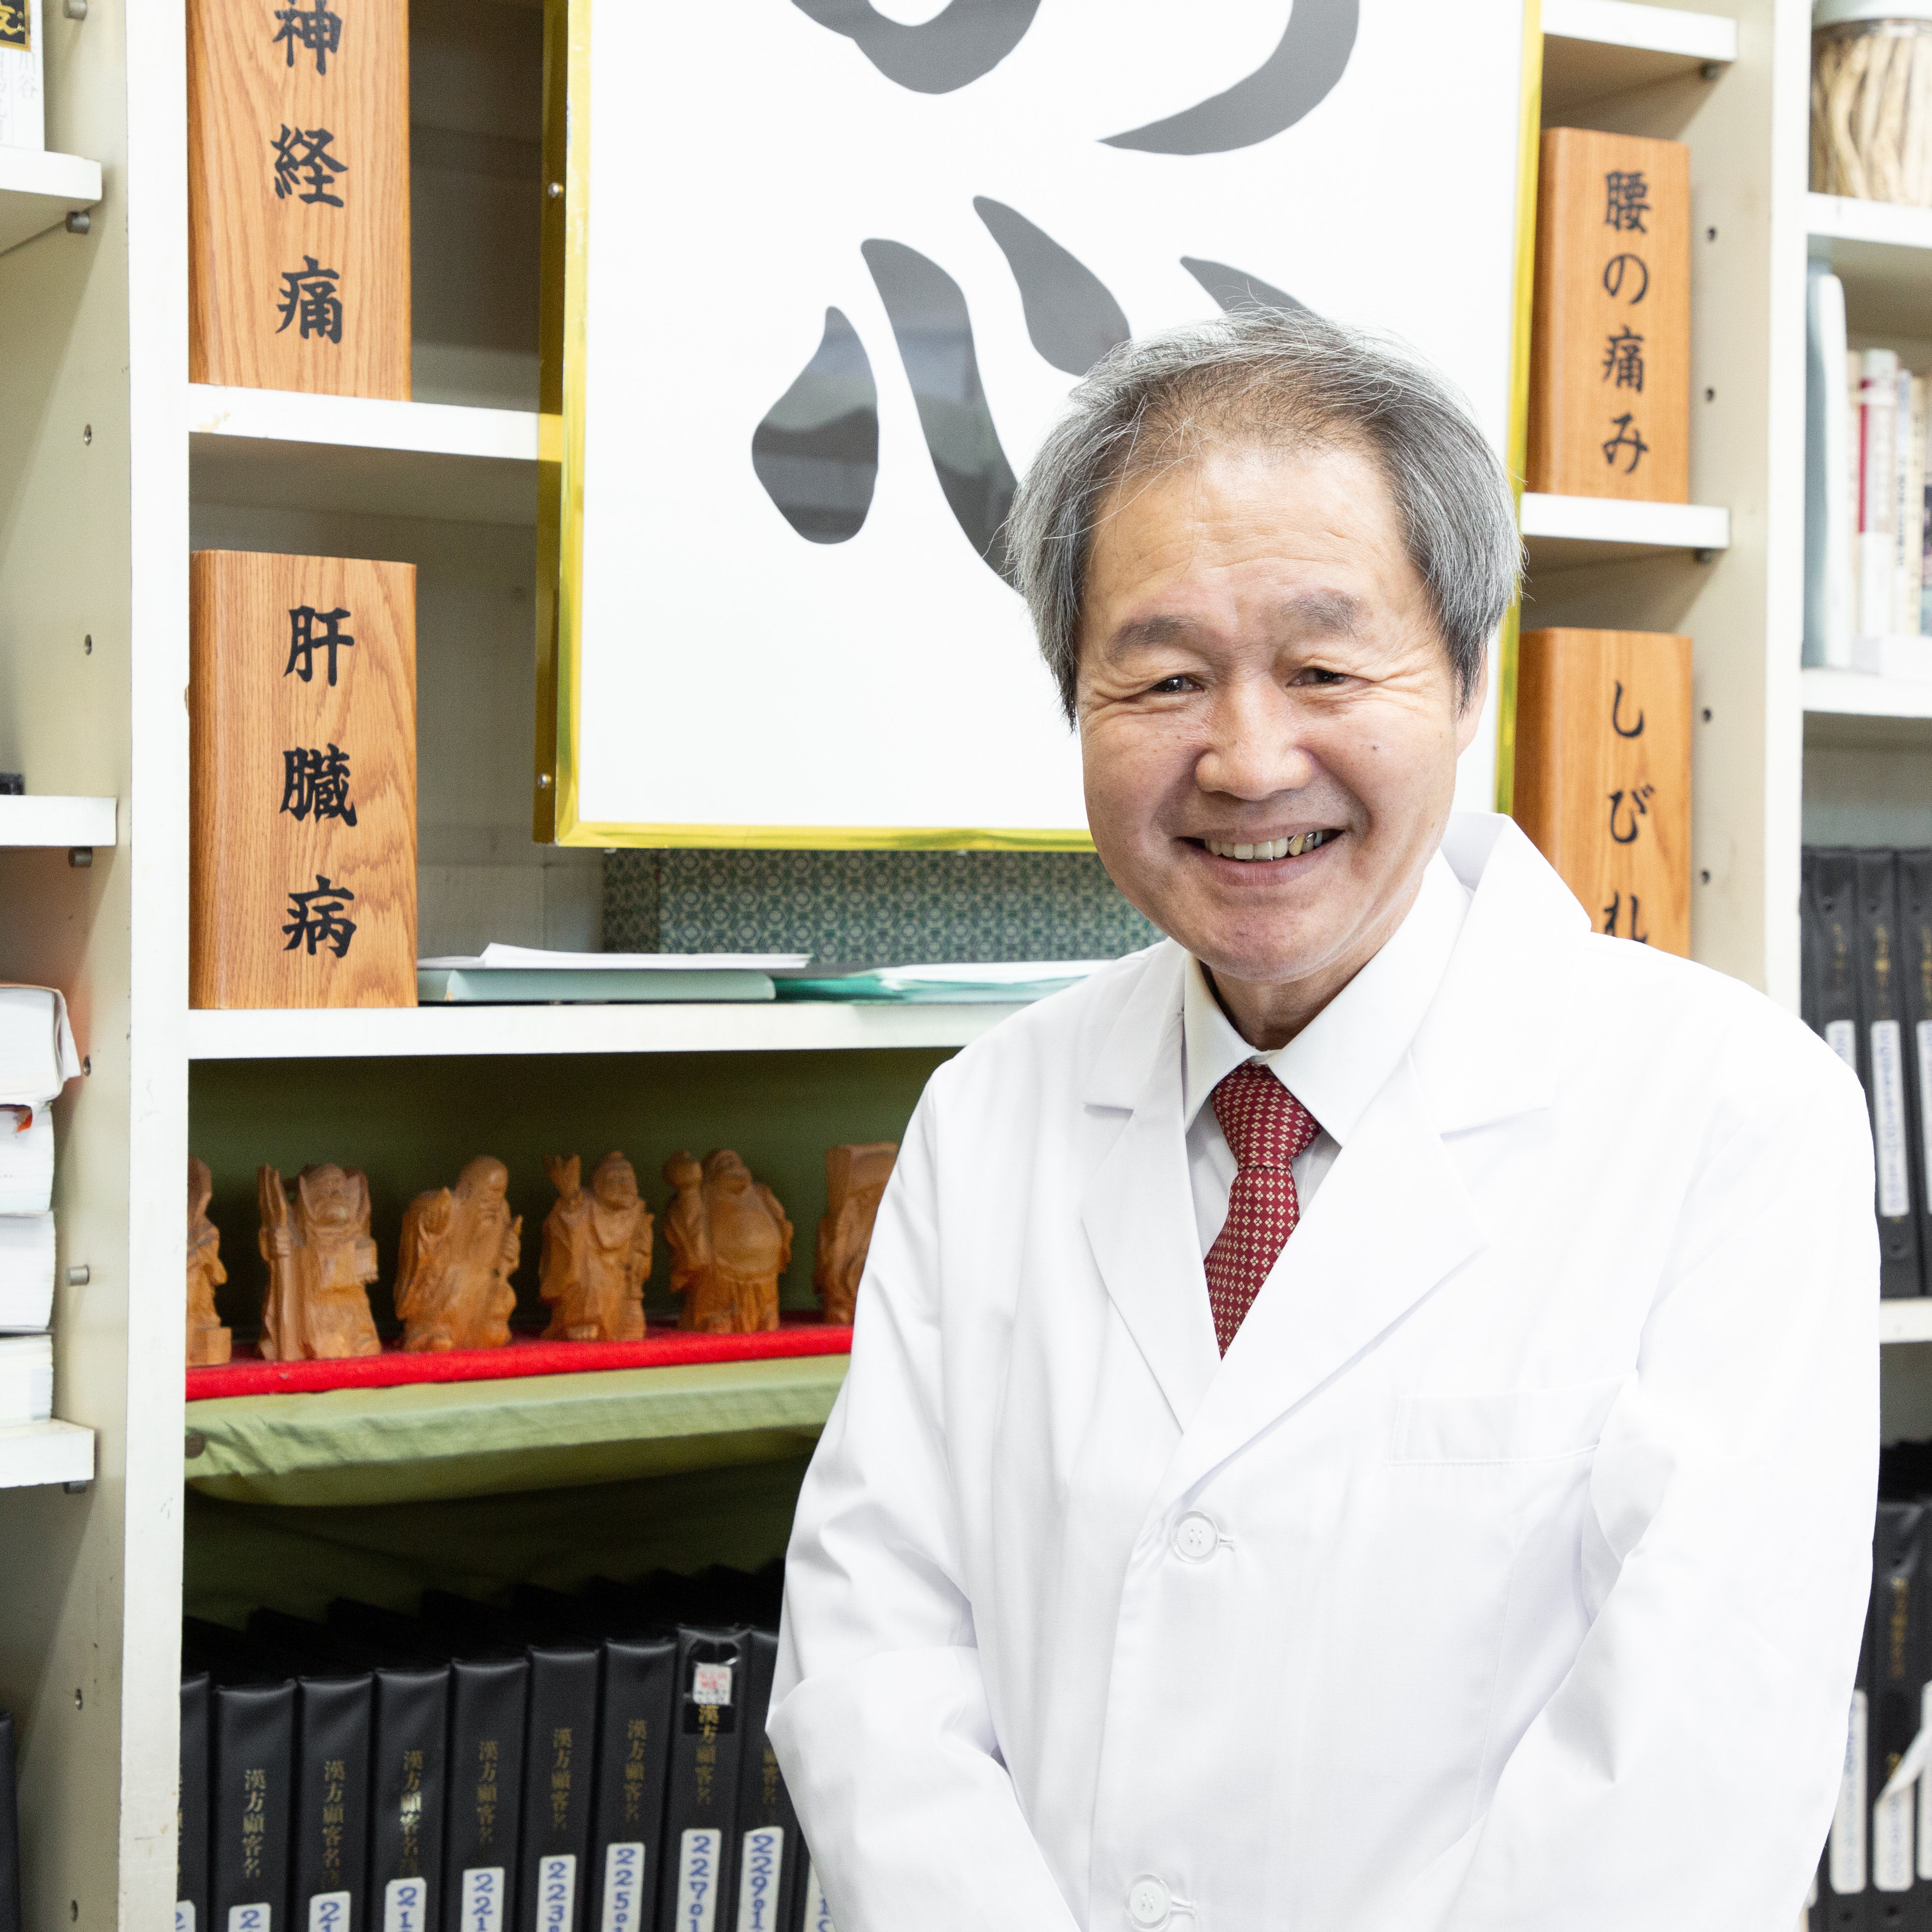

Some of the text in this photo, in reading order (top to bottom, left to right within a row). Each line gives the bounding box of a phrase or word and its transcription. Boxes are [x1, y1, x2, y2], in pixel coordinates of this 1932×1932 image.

[271, 0, 349, 344] 神経痛
[1602, 170, 1651, 474] 腰の痛み
[279, 605, 357, 957] 肝臓病
[1603, 680, 1655, 944] しびれ
[239, 1910, 261, 1932] 2
[397, 1887, 417, 1932] 21
